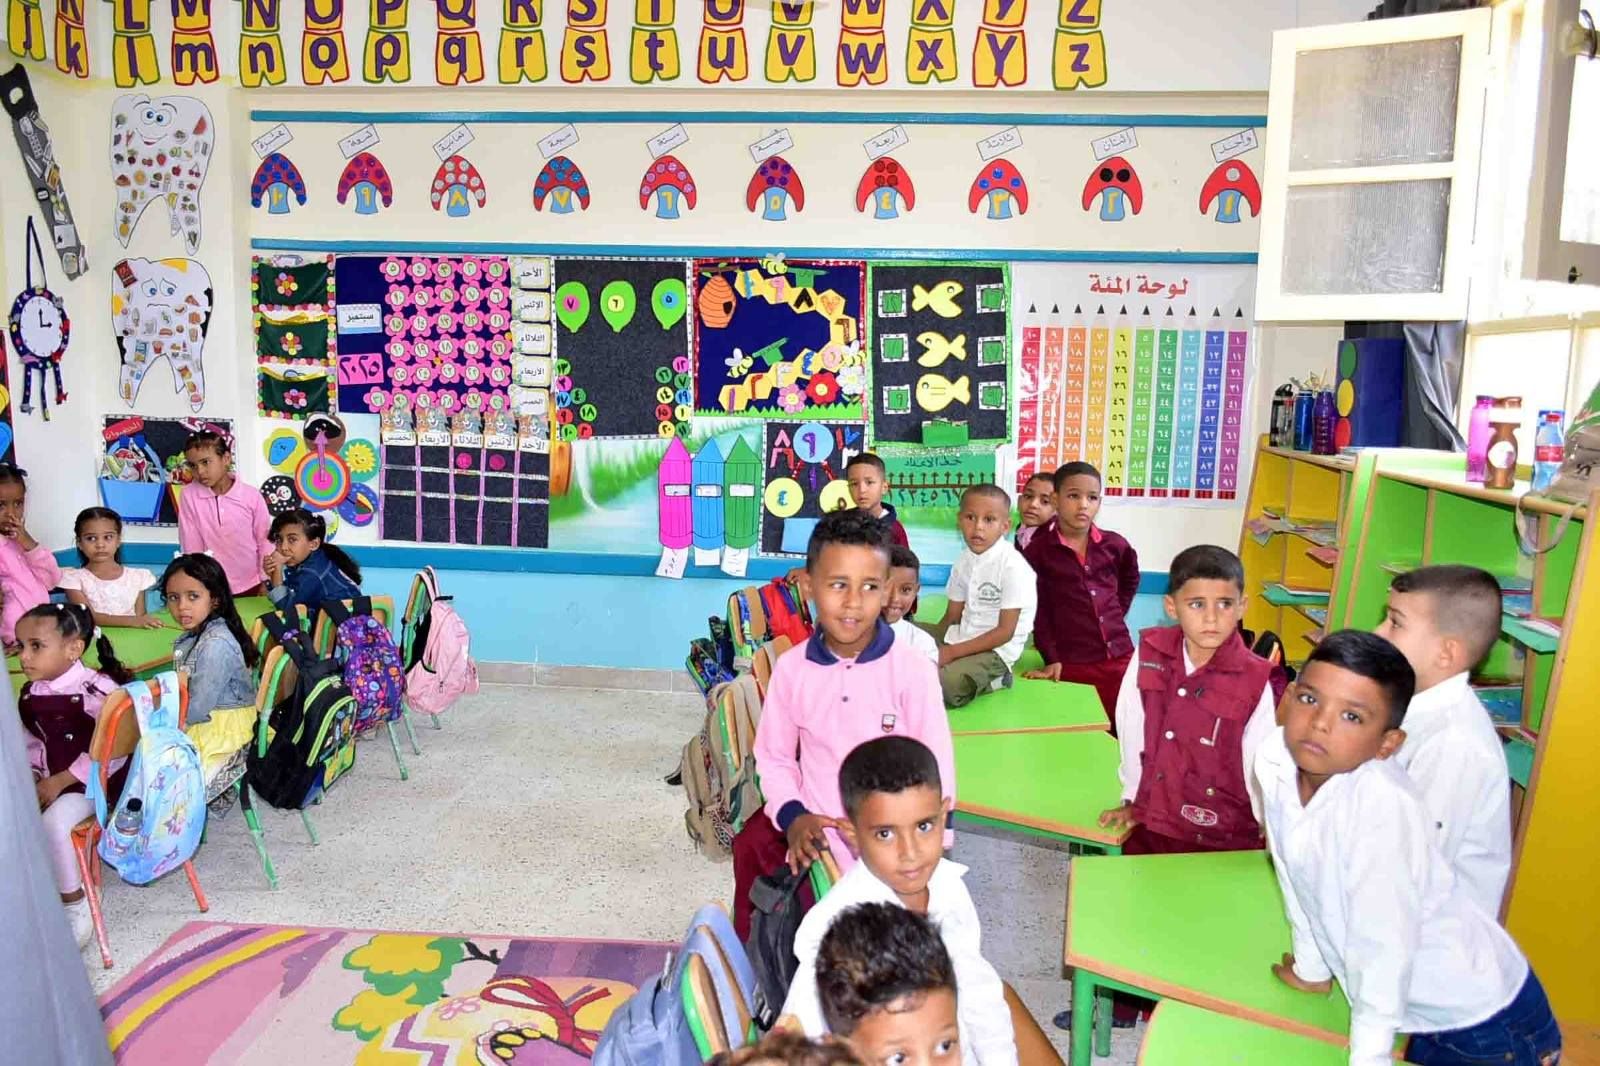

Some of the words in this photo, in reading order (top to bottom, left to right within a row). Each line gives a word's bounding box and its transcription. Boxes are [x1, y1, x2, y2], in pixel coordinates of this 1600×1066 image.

[124, 0, 144, 29] L
[246, 0, 275, 27] N
[435, 0, 476, 27] Q
[65, 26, 82, 72] k
[174, 43, 214, 73] m
[249, 42, 275, 73] n
[310, 37, 338, 68] o
[375, 34, 401, 78] p
[443, 37, 467, 74] q
[515, 37, 532, 68] r
[645, 32, 664, 71] t
[708, 37, 736, 68] u
[361, 187, 372, 208] ٩
[449, 190, 467, 207] ٨
[554, 191, 571, 209] ٧
[661, 191, 674, 212] ٦
[1089, 273, 1131, 295] المئة
[1137, 275, 1189, 299] لوحة
[665, 295, 673, 304] ٥
[793, 288, 814, 309] ٨
[566, 298, 575, 310] ٧
[612, 299, 619, 309] ٦
[835, 318, 850, 344] ٦
[1051, 330, 1057, 339] ٩
[1166, 335, 1170, 343] ٤
[1236, 337, 1240, 345] ١
[1071, 347, 1082, 356] ١٨
[1116, 350, 1127, 358] ١٦
[1233, 353, 1241, 361] ١١
[340, 355, 380, 383] ٢٠٢٥
[557, 363, 568, 374] ١٣
[678, 377, 687, 387] ٧
[660, 388, 671, 400] ١٤
[678, 391, 688, 401] ١٩
[557, 395, 568, 406] ١٧
[1113, 398, 1125, 406] ٤٦
[1229, 401, 1238, 409] ٤١
[582, 406, 595, 418] ١٨
[1227, 417, 1237, 425] ٥١
[564, 427, 573, 437] ١٠
[1226, 432, 1237, 440] ٦١
[774, 429, 791, 448] ٨
[802, 432, 816, 459] ٩
[1225, 448, 1236, 456] ٧١
[1224, 464, 1234, 473] ٨١
[1108, 476, 1121, 484] ٩٦
[1223, 479, 1234, 487] ٩١
[930, 489, 938, 501] ٥
